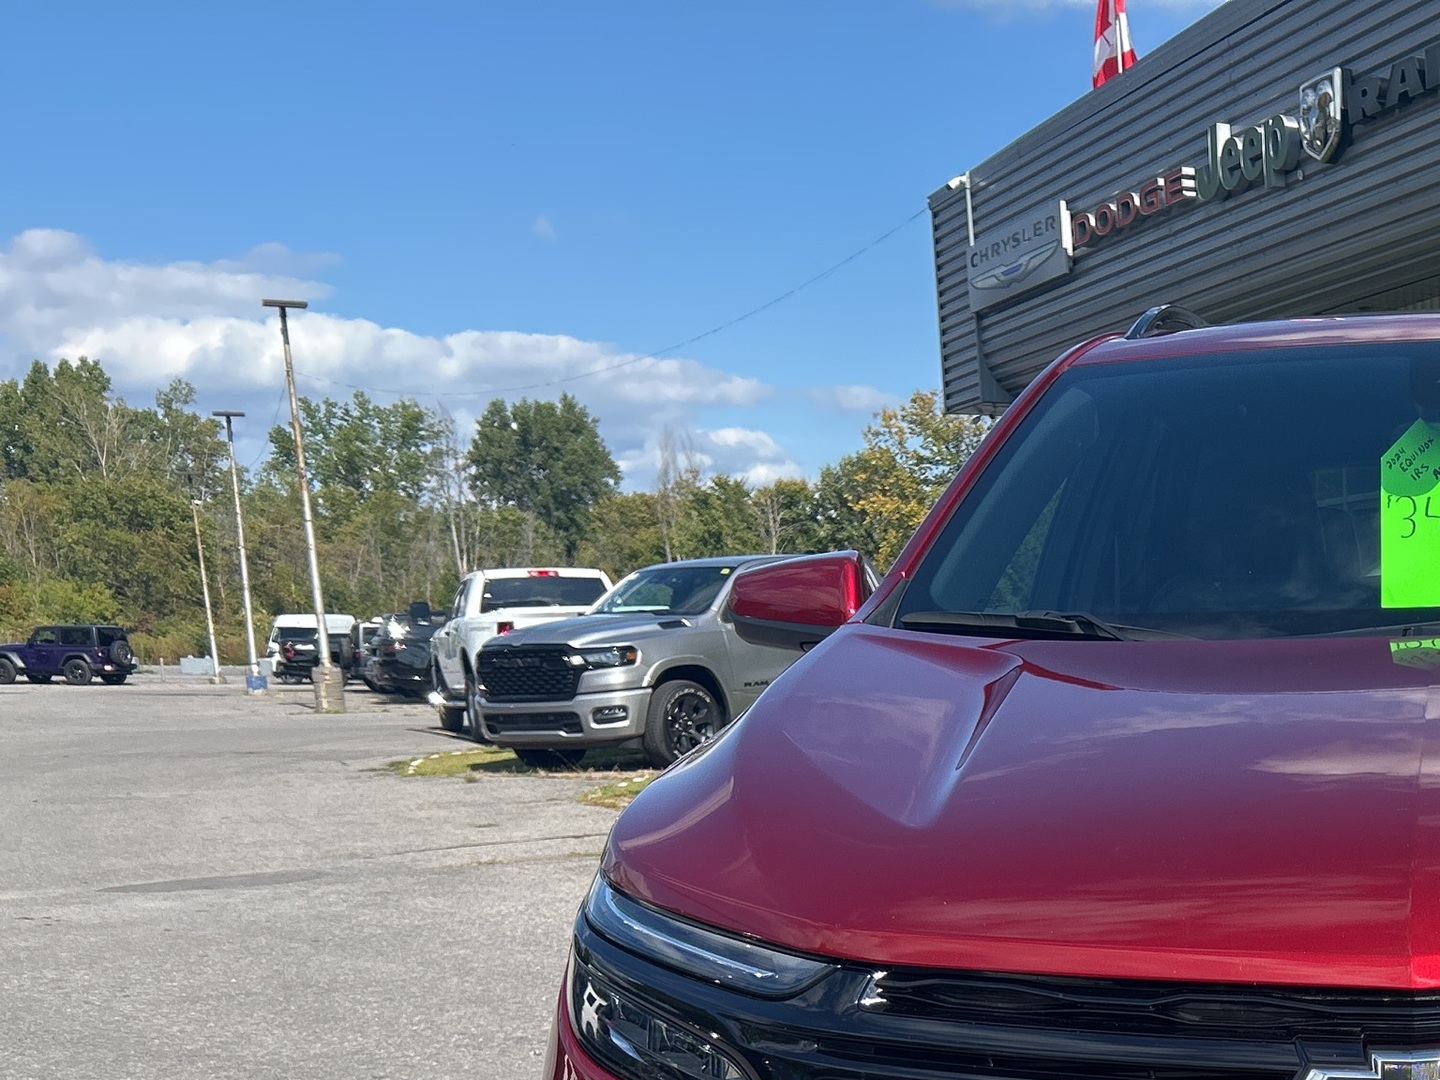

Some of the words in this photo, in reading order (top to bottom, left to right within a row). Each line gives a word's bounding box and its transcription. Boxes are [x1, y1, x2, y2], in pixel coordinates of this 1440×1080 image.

[1196, 114, 1299, 201] Jeep
[1072, 166, 1194, 247] DODGE
[969, 214, 1056, 268] CHRYSLER
[1385, 446, 1407, 471] 2024
[1399, 436, 1434, 473] EQUINOX
